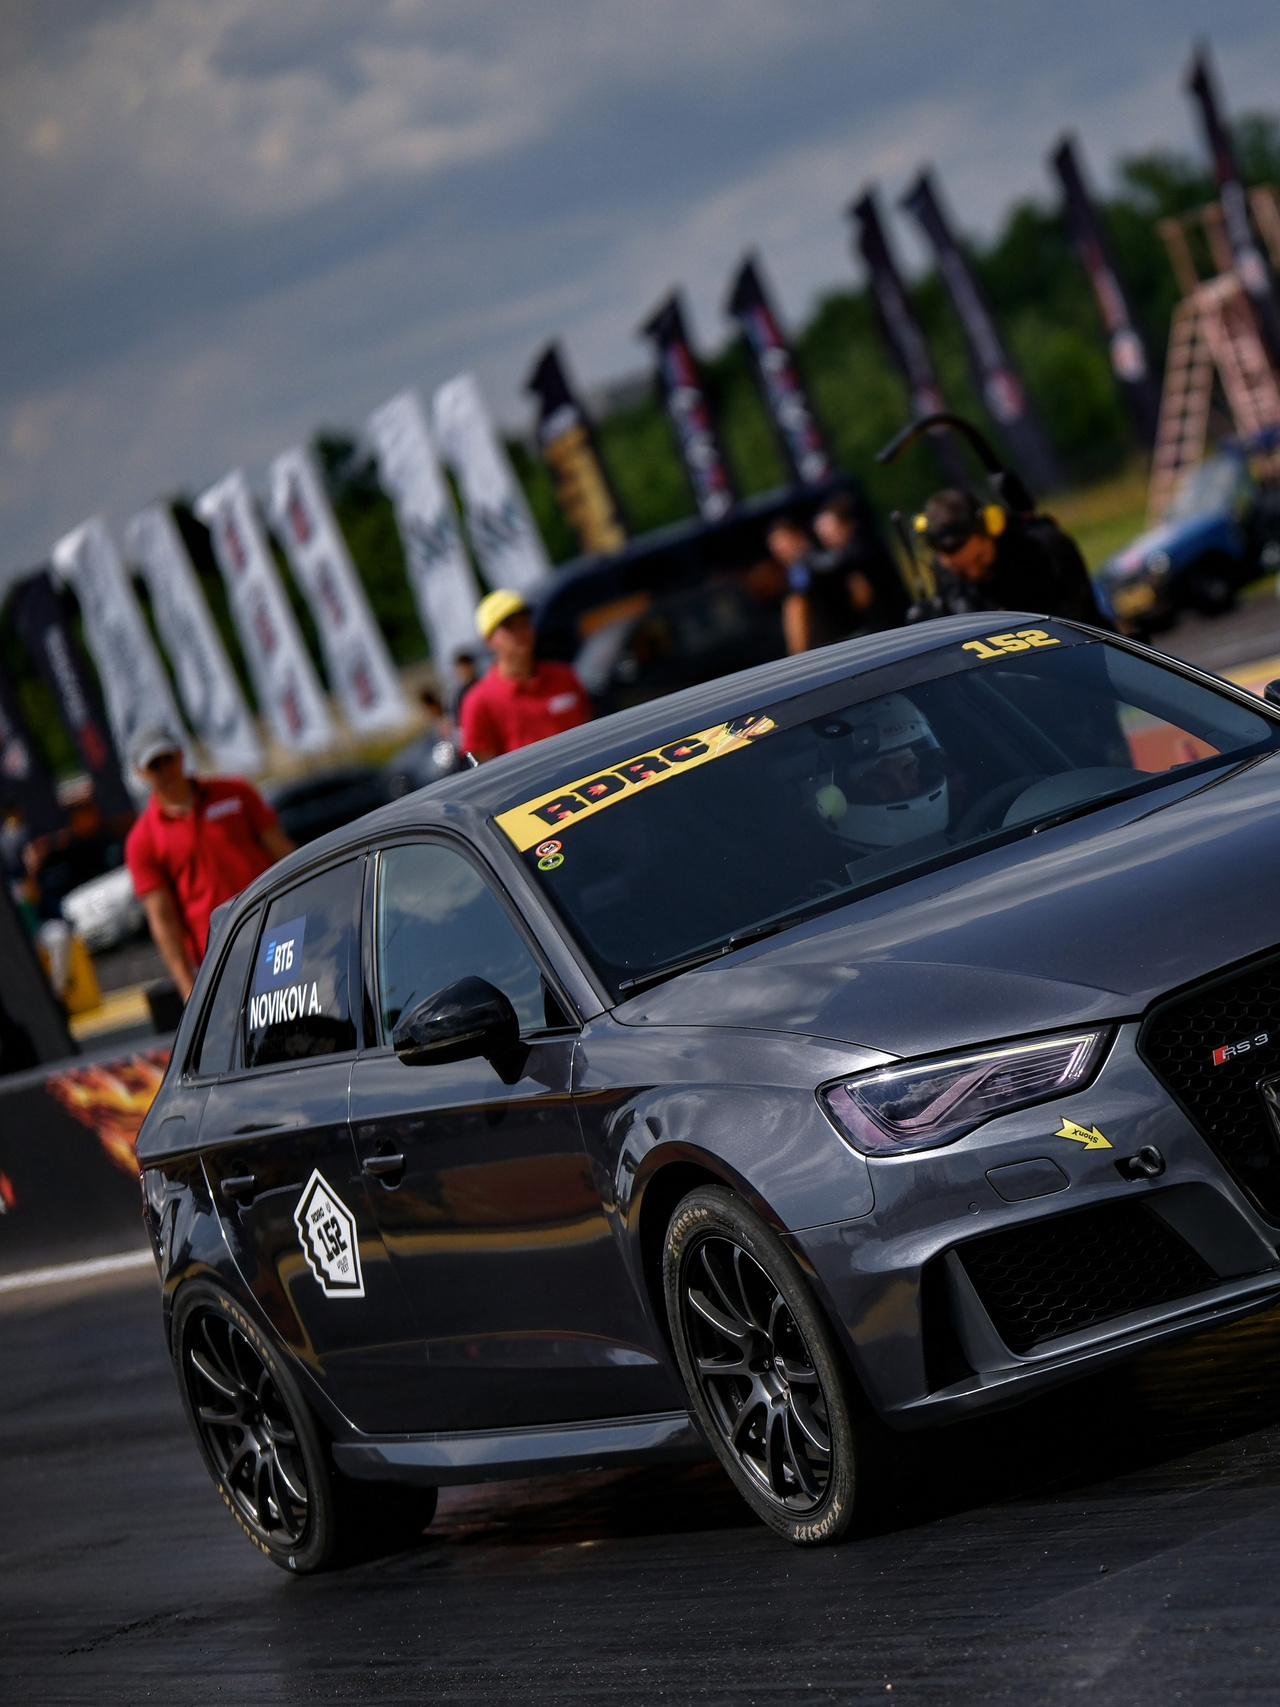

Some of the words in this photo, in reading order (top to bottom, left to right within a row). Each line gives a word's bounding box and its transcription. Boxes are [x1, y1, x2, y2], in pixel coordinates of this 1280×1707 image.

[961, 629, 1061, 660] 152
[249, 983, 308, 1031] NOVIKOV
[308, 981, 323, 1017] A.
[1221, 1038, 1251, 1058] RS
[1254, 1032, 1270, 1048] 3
[317, 1214, 348, 1263] 152
